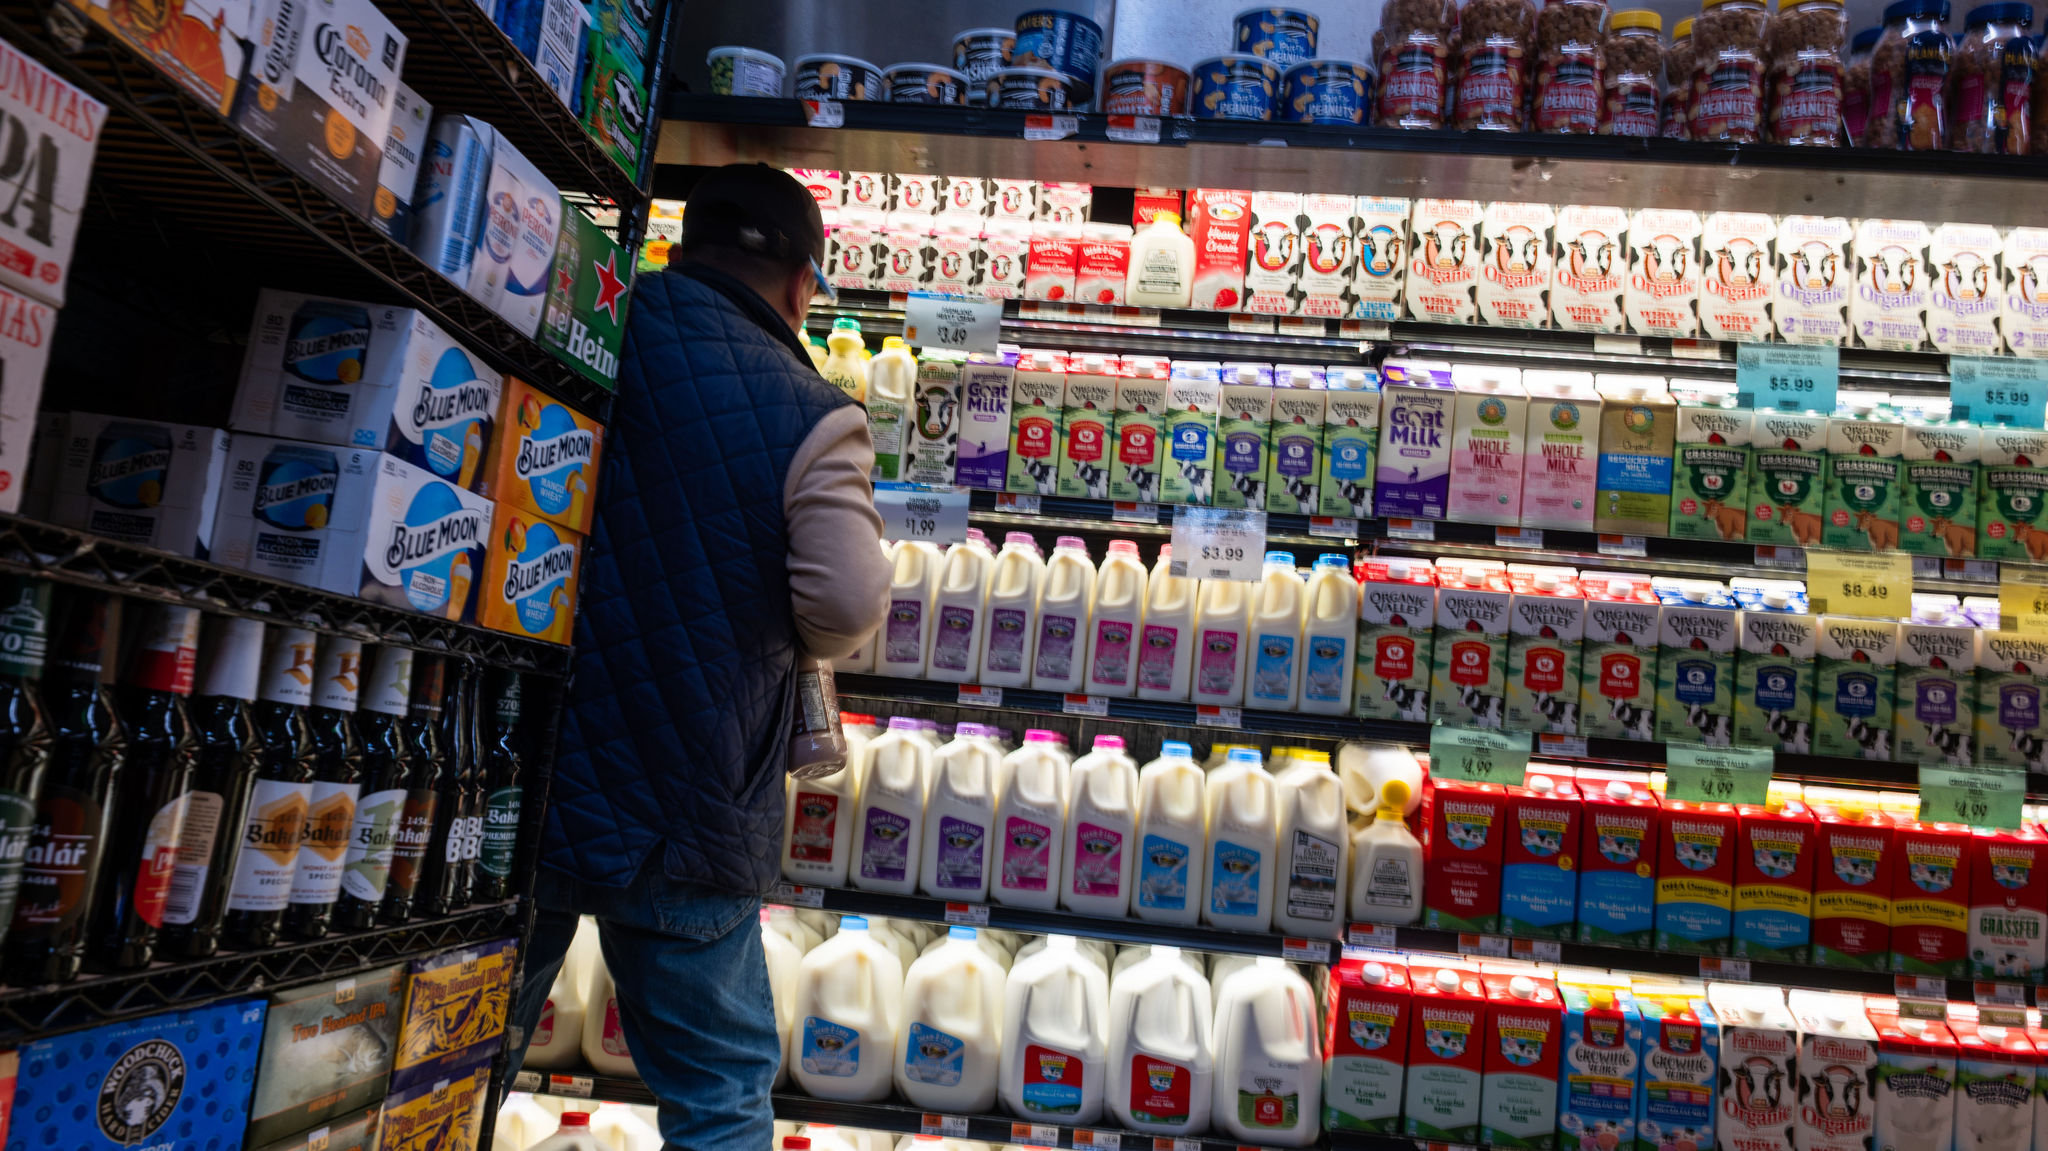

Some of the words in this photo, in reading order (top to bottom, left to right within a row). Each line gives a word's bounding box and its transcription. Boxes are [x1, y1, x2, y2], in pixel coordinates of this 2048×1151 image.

[314, 22, 386, 109] Corona
[327, 67, 366, 119] Extra
[1386, 82, 1439, 98] PEANUTS
[1460, 83, 1513, 101] PEANUTS
[1219, 103, 1264, 119] PEANUTS
[1308, 102, 1356, 118] PEANUTS
[1543, 94, 1598, 110] PEANUTS
[1700, 101, 1755, 117] PEANUTS
[1780, 102, 1837, 118] PEANUTS
[522, 207, 553, 241] PERONI
[1208, 226, 1240, 241] Heavy
[1206, 240, 1239, 254] Cream
[1412, 258, 1476, 287] Organic
[1484, 264, 1548, 291] Organic
[1557, 269, 1622, 296] Organic
[1631, 274, 1696, 300] Organic
[1705, 277, 1771, 304] Organic
[1253, 295, 1286, 305] HEAVY
[1779, 281, 1846, 308] Organic
[1859, 284, 1926, 311] Organic
[1250, 304, 1288, 315] CREAM
[1303, 308, 1342, 318] CREAM
[1305, 299, 1338, 309] HEAVY
[1358, 301, 1394, 311] LIGHT
[1424, 305, 1456, 316] MILK
[1932, 291, 2000, 318] Organic
[1356, 310, 1395, 321] CREAM
[1496, 309, 1528, 320] MILK
[1571, 314, 1604, 325] MILK
[1645, 318, 1679, 329] MILK
[937, 325, 968, 345] $3.49
[1719, 322, 1753, 333] MILK
[286, 337, 327, 363] BLUE
[330, 330, 367, 348] MOON
[917, 367, 961, 381] Farmland
[968, 382, 1009, 399] Goat
[1769, 375, 1815, 392] $5.99
[413, 387, 456, 427] BLUE
[458, 382, 490, 411] MOON
[967, 398, 1007, 415] Milk
[1985, 389, 2030, 406] $5.99
[1390, 407, 1444, 429] Goat
[1389, 427, 1442, 448] Milk
[516, 439, 556, 475] BLUE
[557, 434, 590, 461] MOON
[1468, 438, 1511, 456] WHOLE
[1541, 443, 1585, 460] WHOLE
[1472, 454, 1504, 469] MILK
[1546, 458, 1578, 474] MILK
[256, 485, 294, 507] BLUE
[298, 474, 335, 497] MOON
[905, 517, 936, 536] $1.99
[386, 526, 437, 569] BLUE
[439, 516, 478, 548] MOON
[1201, 545, 1245, 562] $3.99
[505, 563, 546, 600] BLUE
[547, 550, 573, 580] MOON
[1369, 589, 1428, 608] ORGANIC
[1445, 595, 1505, 614] ORGANIC
[1375, 600, 1423, 617] VALLEY
[1451, 605, 1499, 623] VALLEY
[1518, 601, 1578, 620] ORGANIC
[1593, 606, 1653, 627] ORGANIC
[1525, 612, 1574, 629] VALLEY
[1599, 617, 1648, 634] VALLEY
[1668, 615, 1729, 635] ORGANIC
[1748, 619, 1810, 639] ORGANIC
[1674, 626, 1725, 641] VALLEY
[1755, 630, 1806, 645] VALLEY
[1829, 625, 1895, 644] ORGANIC
[1906, 630, 1970, 650] ORGANIC
[1836, 636, 1887, 651] VALLEY
[1914, 641, 1965, 658] VALLEY
[1989, 638, 2048, 656] ORGANIC
[1997, 649, 2045, 665] VALLEY
[1462, 756, 1493, 776] $4.99
[1701, 778, 1734, 799] $4.99
[1444, 801, 1495, 817] HORIZON
[1518, 806, 1570, 823] HORIZON
[1595, 812, 1648, 830] HORIZON
[1672, 819, 1725, 837] HORIZON
[1750, 826, 1804, 844] HORIZON
[1830, 833, 1884, 851] HORIZON
[1906, 841, 1960, 858] HORIZON
[1988, 845, 2035, 859] HORIZON
[1979, 916, 2040, 939] GRASSFED
[1347, 997, 1399, 1018] HORIZON
[1422, 1006, 1474, 1025] HORIZON
[291, 1024, 317, 1042] Two
[320, 1007, 367, 1034] Hearted
[369, 1002, 387, 1021] IPA
[1497, 1013, 1550, 1033] HORIZON
[1732, 1032, 1788, 1052] Farmland
[1812, 1038, 1868, 1062] Farmland
[1575, 1050, 1630, 1066] GROWING
[1652, 1056, 1707, 1073] GROWING
[103, 1042, 184, 1095] WOODCHUCK
[1588, 1063, 1618, 1075] YEARS
[1664, 1069, 1694, 1082] YEARS
[101, 1103, 127, 1137] HARD
[149, 1088, 180, 1130] CIDER
[1723, 1097, 1793, 1127] Organic
[1801, 1104, 1872, 1136] Organic
